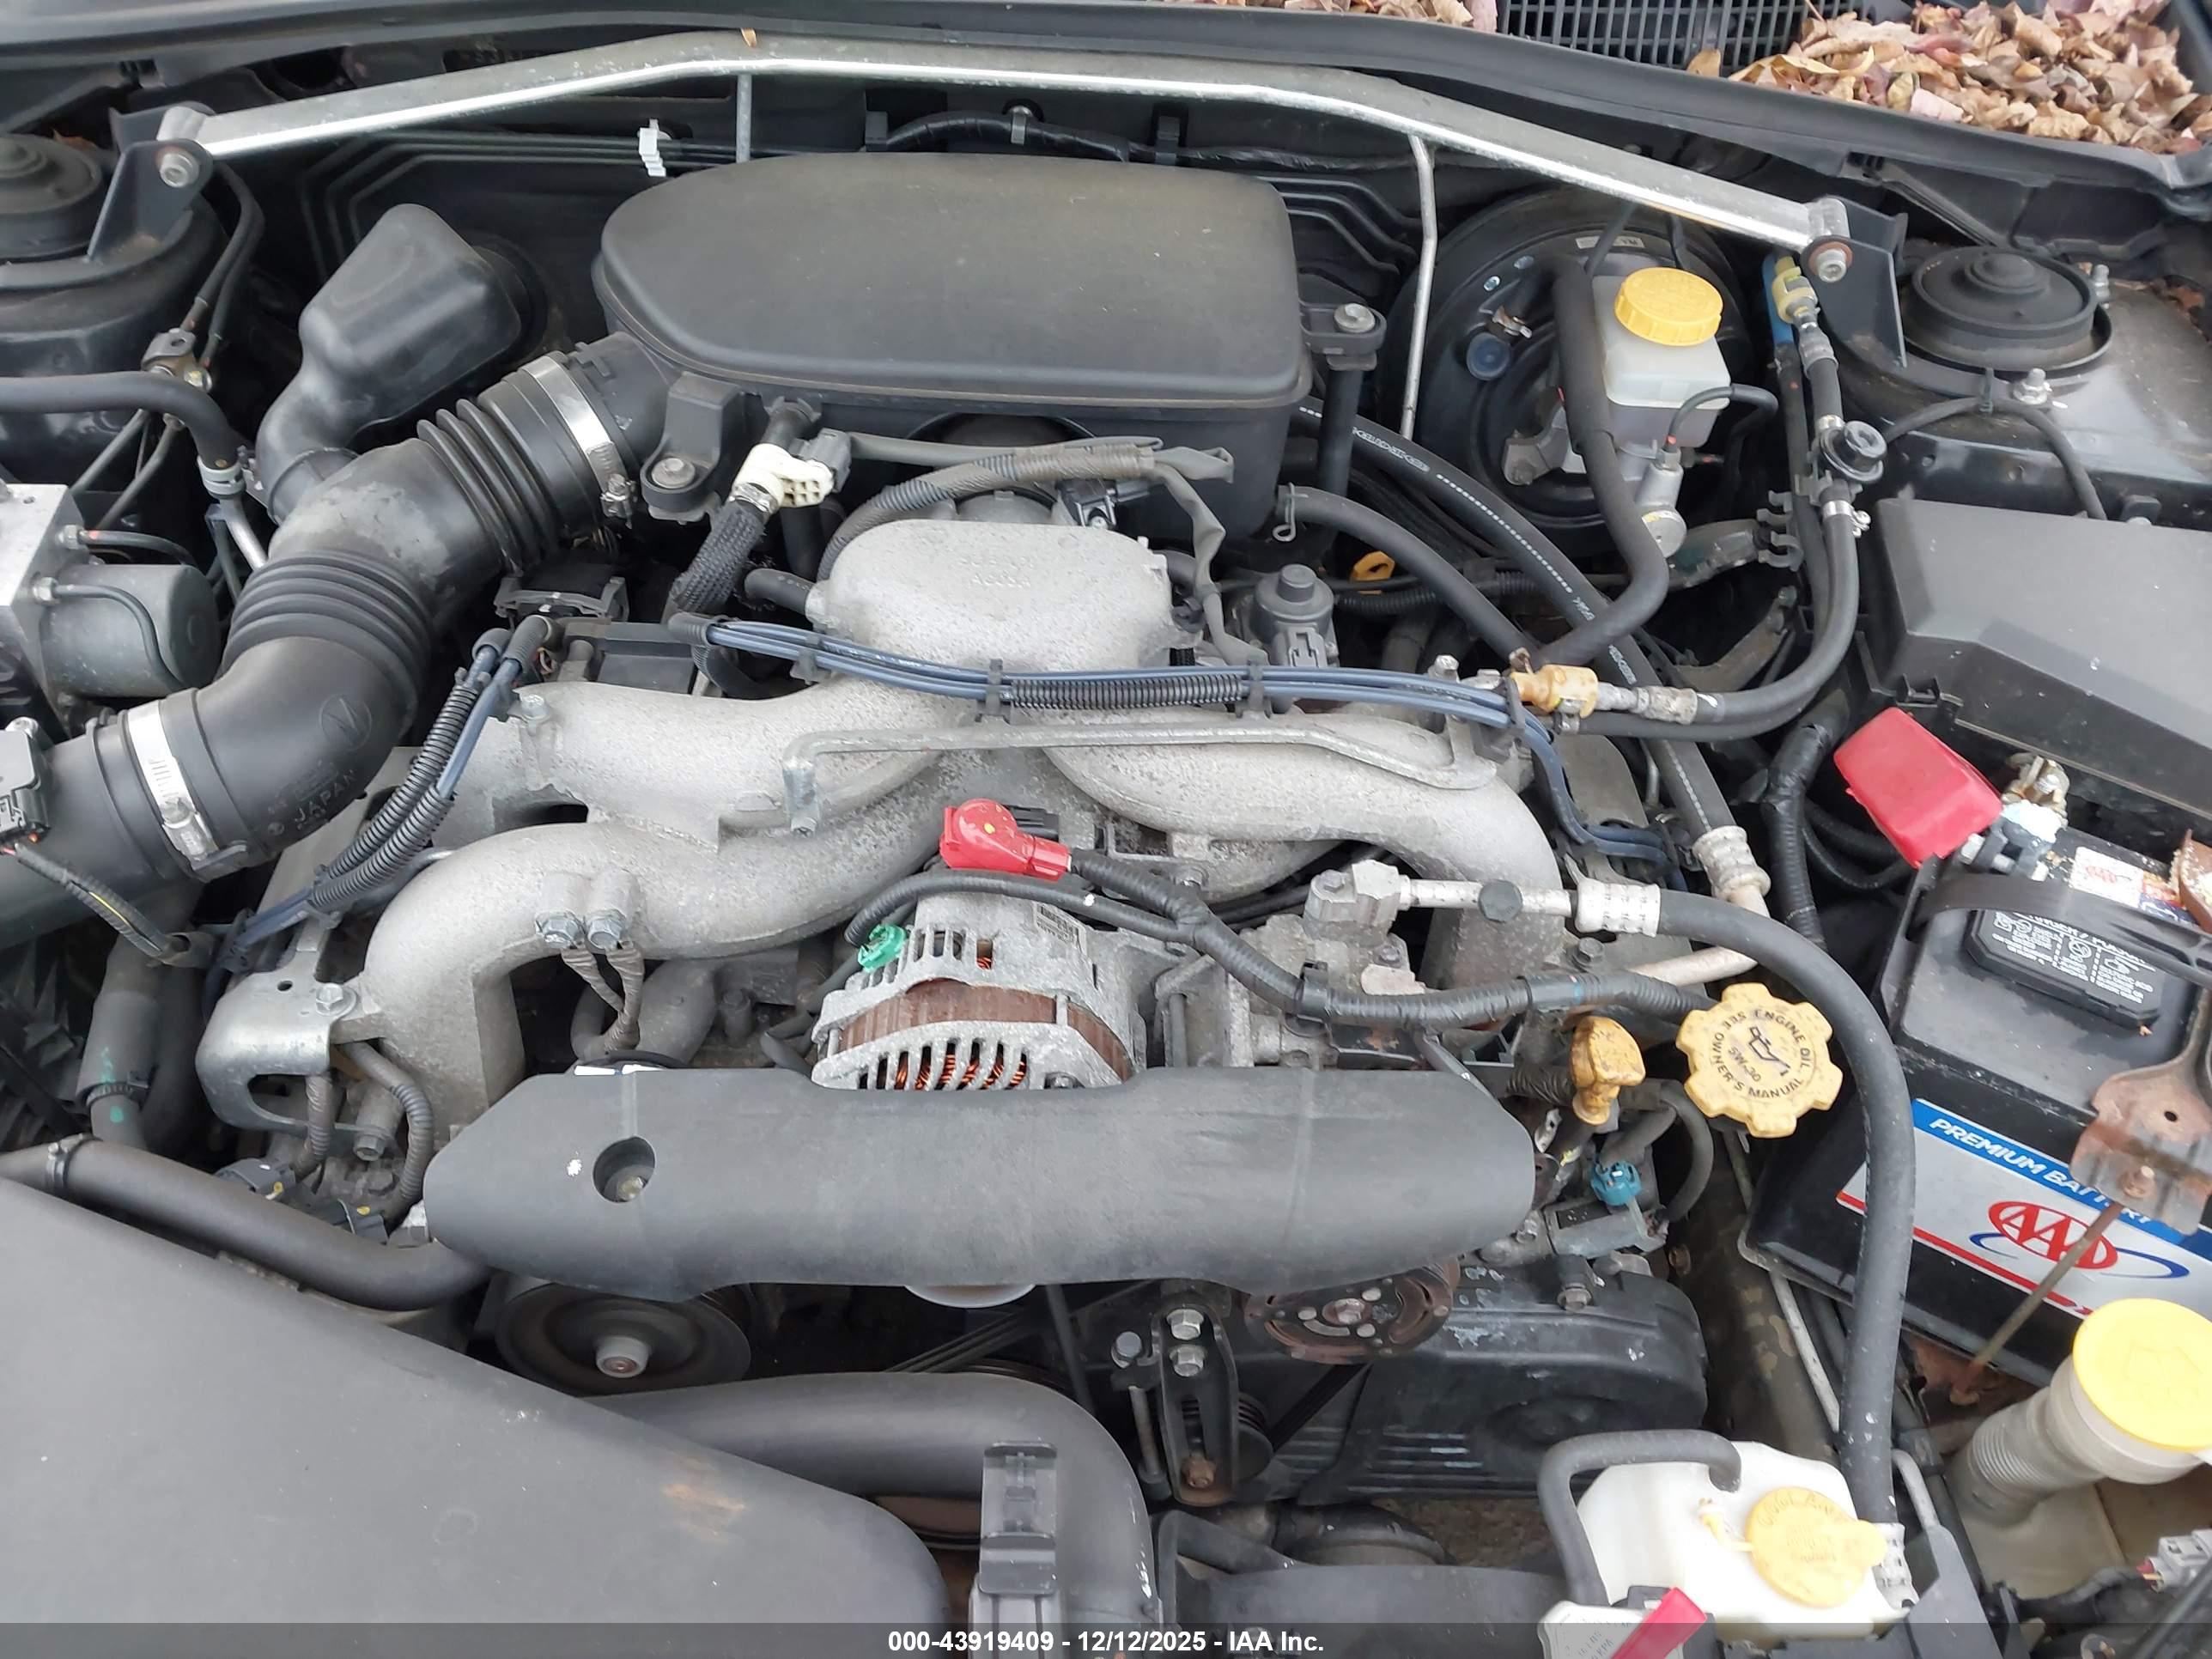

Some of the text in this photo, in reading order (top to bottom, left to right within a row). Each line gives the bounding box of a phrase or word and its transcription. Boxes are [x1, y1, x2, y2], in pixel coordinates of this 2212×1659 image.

[1728, 1047, 1762, 1082] 5W-30
[1753, 1009, 1811, 1068] ENGINE OIL
[1748, 1078, 1804, 1098] MANUAL
[1929, 1118, 2047, 1175] PREMIUM
[1990, 1202, 2117, 1269] AAA
